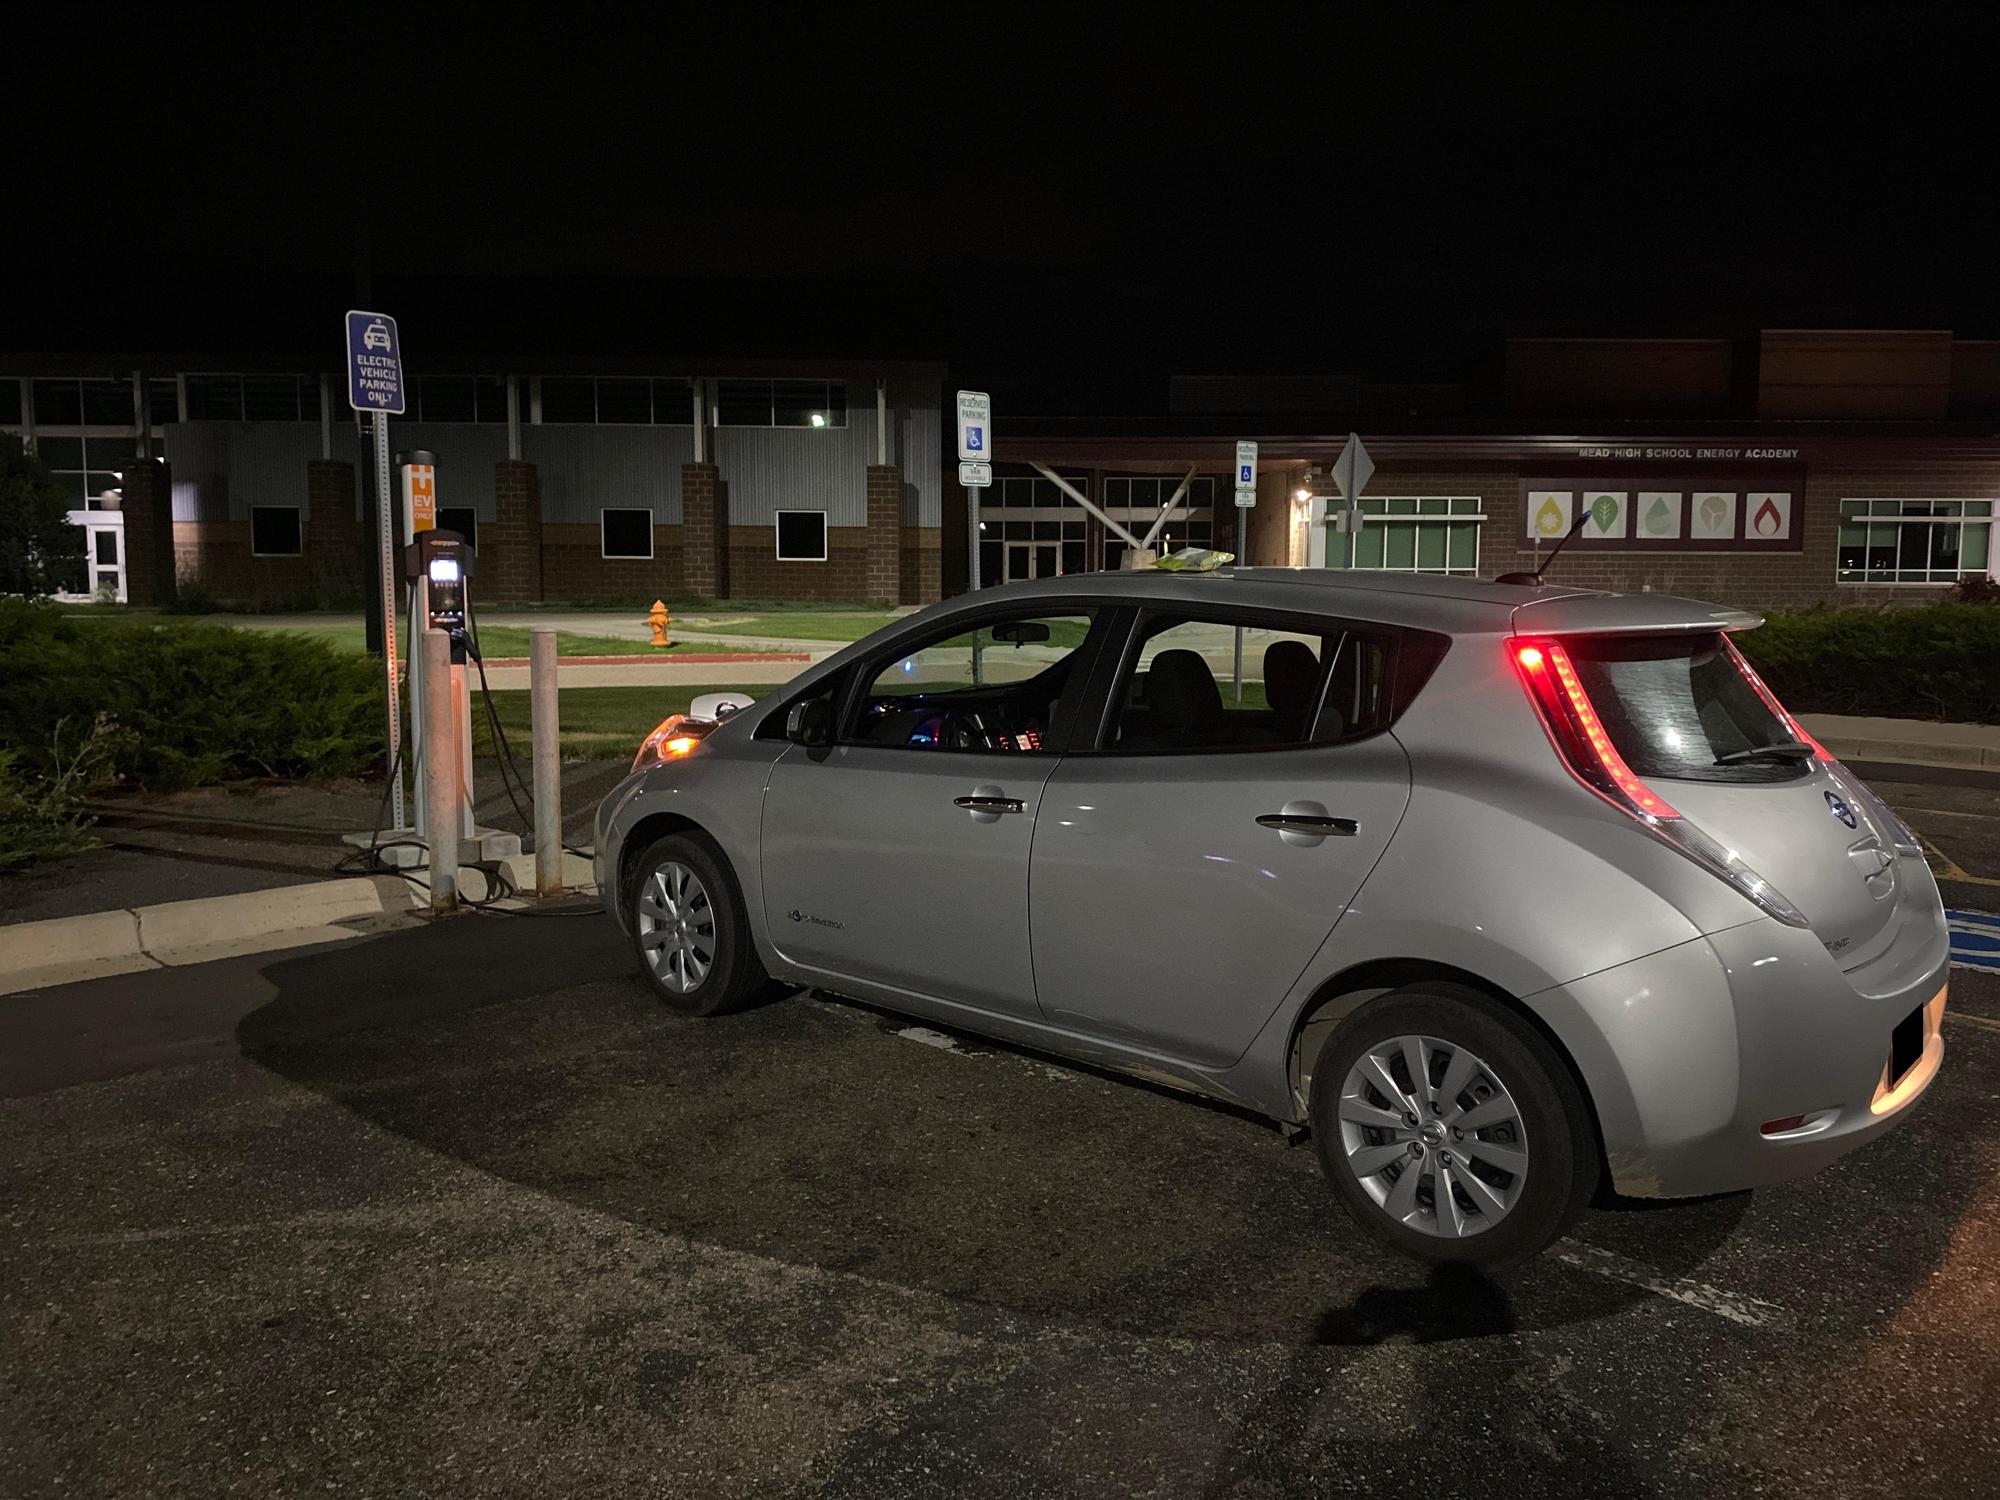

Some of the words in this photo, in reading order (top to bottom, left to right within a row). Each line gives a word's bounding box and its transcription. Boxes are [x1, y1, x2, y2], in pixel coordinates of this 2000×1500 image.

[360, 366, 396, 380] VEHICLE
[359, 378, 397, 392] PARKING
[368, 390, 392, 402] ONLY
[960, 397, 988, 409] RESERVED
[962, 409, 986, 420] PARKING
[1579, 449, 1610, 458] MEAD
[1615, 449, 1641, 458] HIGH
[1646, 449, 1692, 458] SCHOOL
[1696, 449, 1741, 458] ENERGY
[1745, 449, 1799, 458] ACADEMY
[414, 495, 431, 507] EV
[414, 512, 432, 520] ONLY
